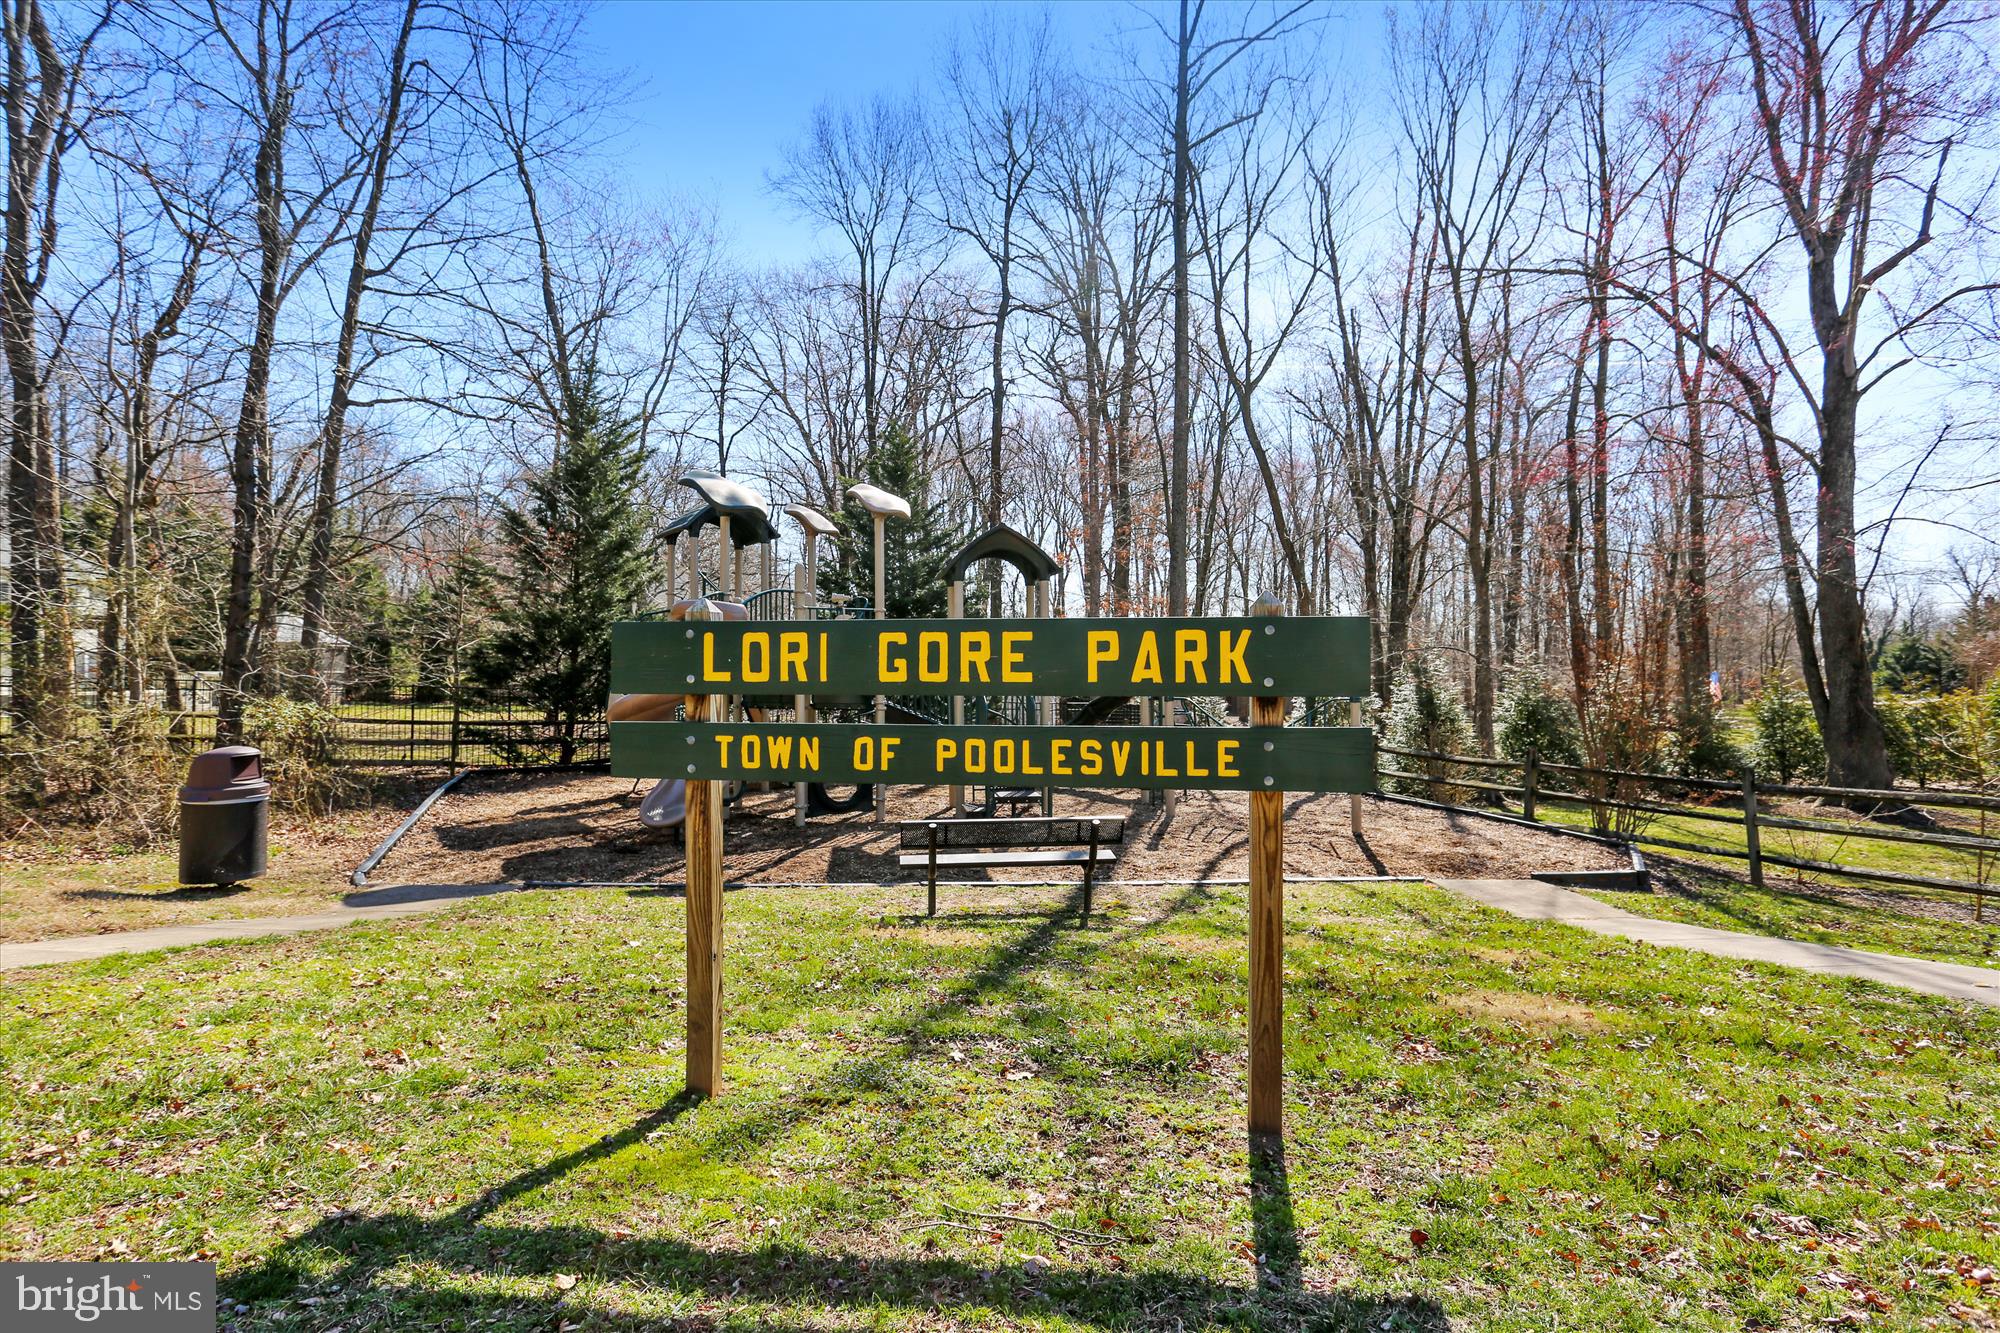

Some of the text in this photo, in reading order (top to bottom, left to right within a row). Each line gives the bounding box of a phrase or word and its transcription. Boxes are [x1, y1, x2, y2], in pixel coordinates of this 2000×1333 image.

[703, 628, 1253, 684] LORI GORE PARK
[714, 734, 1240, 778] TOWN OF POOLESVILLE
